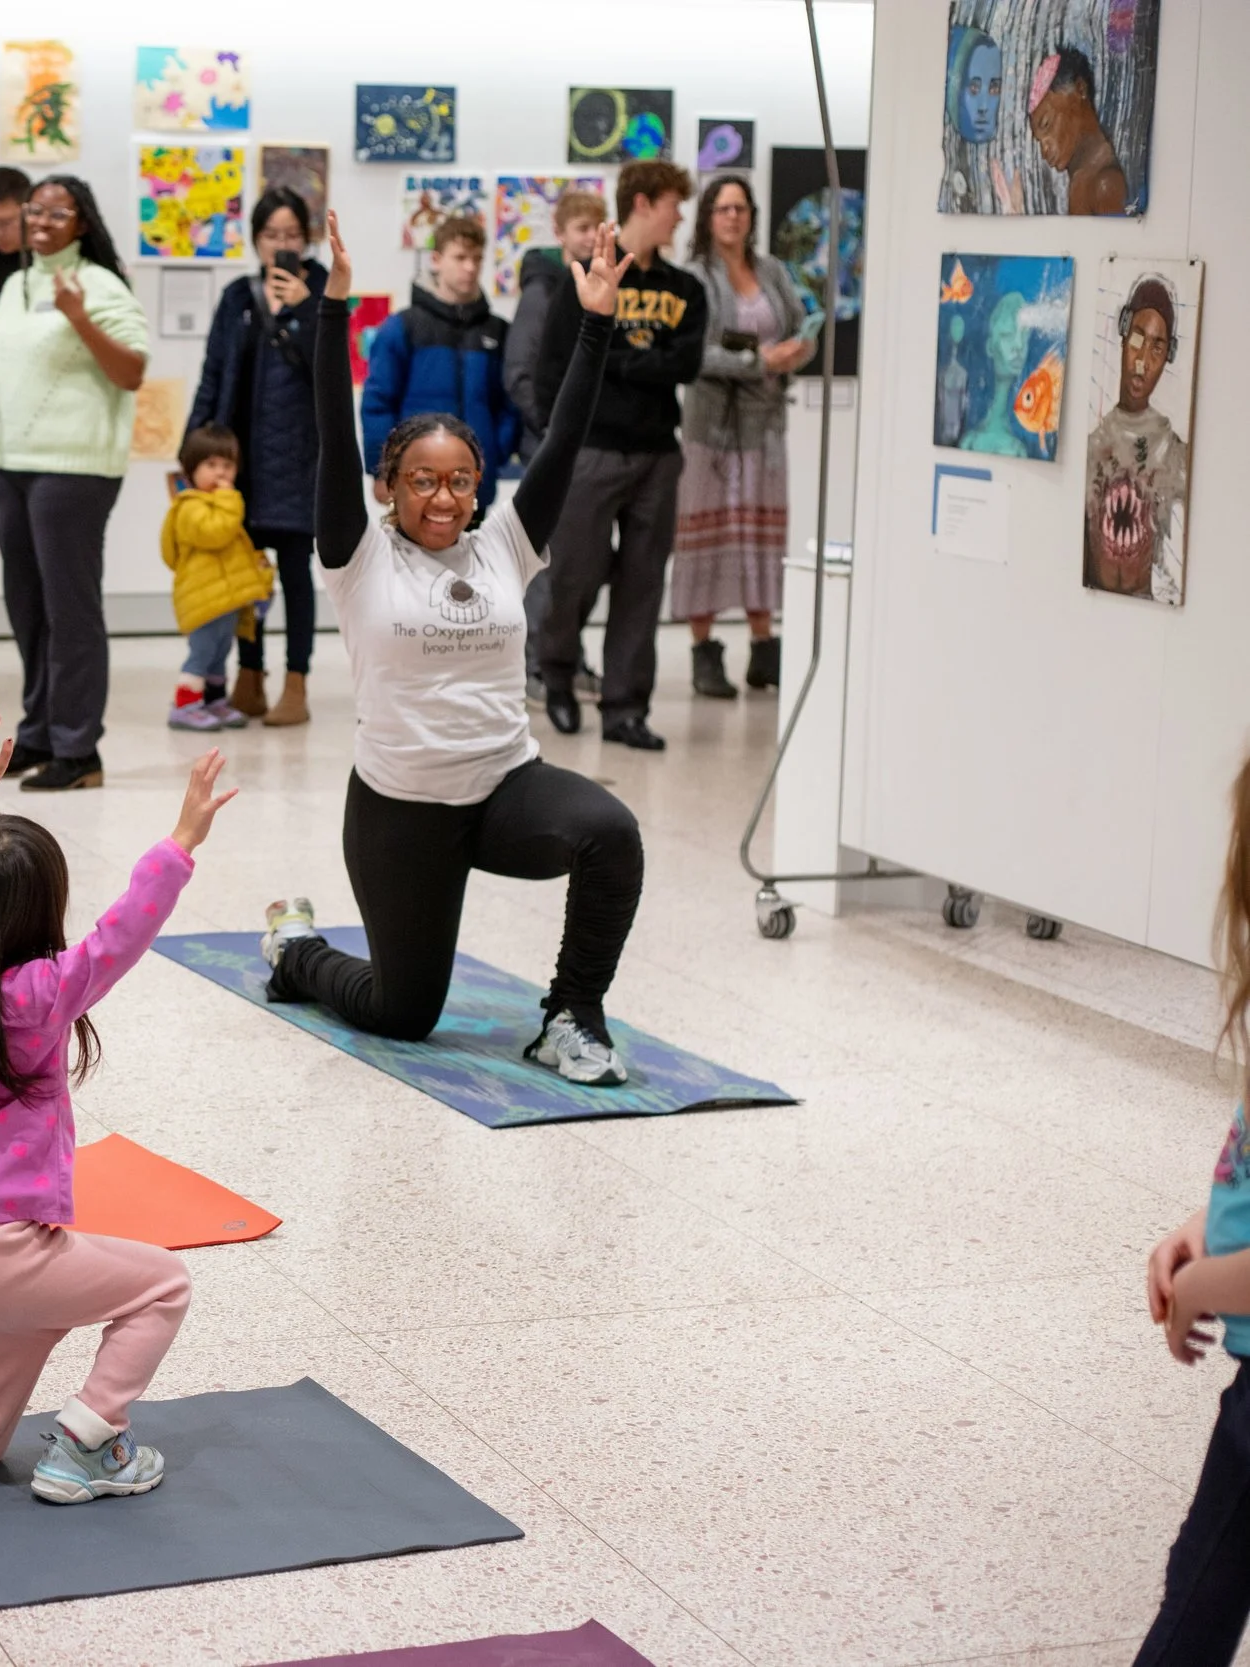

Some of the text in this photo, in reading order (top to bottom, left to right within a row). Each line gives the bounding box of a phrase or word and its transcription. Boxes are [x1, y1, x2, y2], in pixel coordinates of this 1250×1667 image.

[617, 287, 687, 328] IZZOU
[392, 621, 524, 641] The Oxygen Projec
[422, 638, 506, 656] (yoga for youth)
